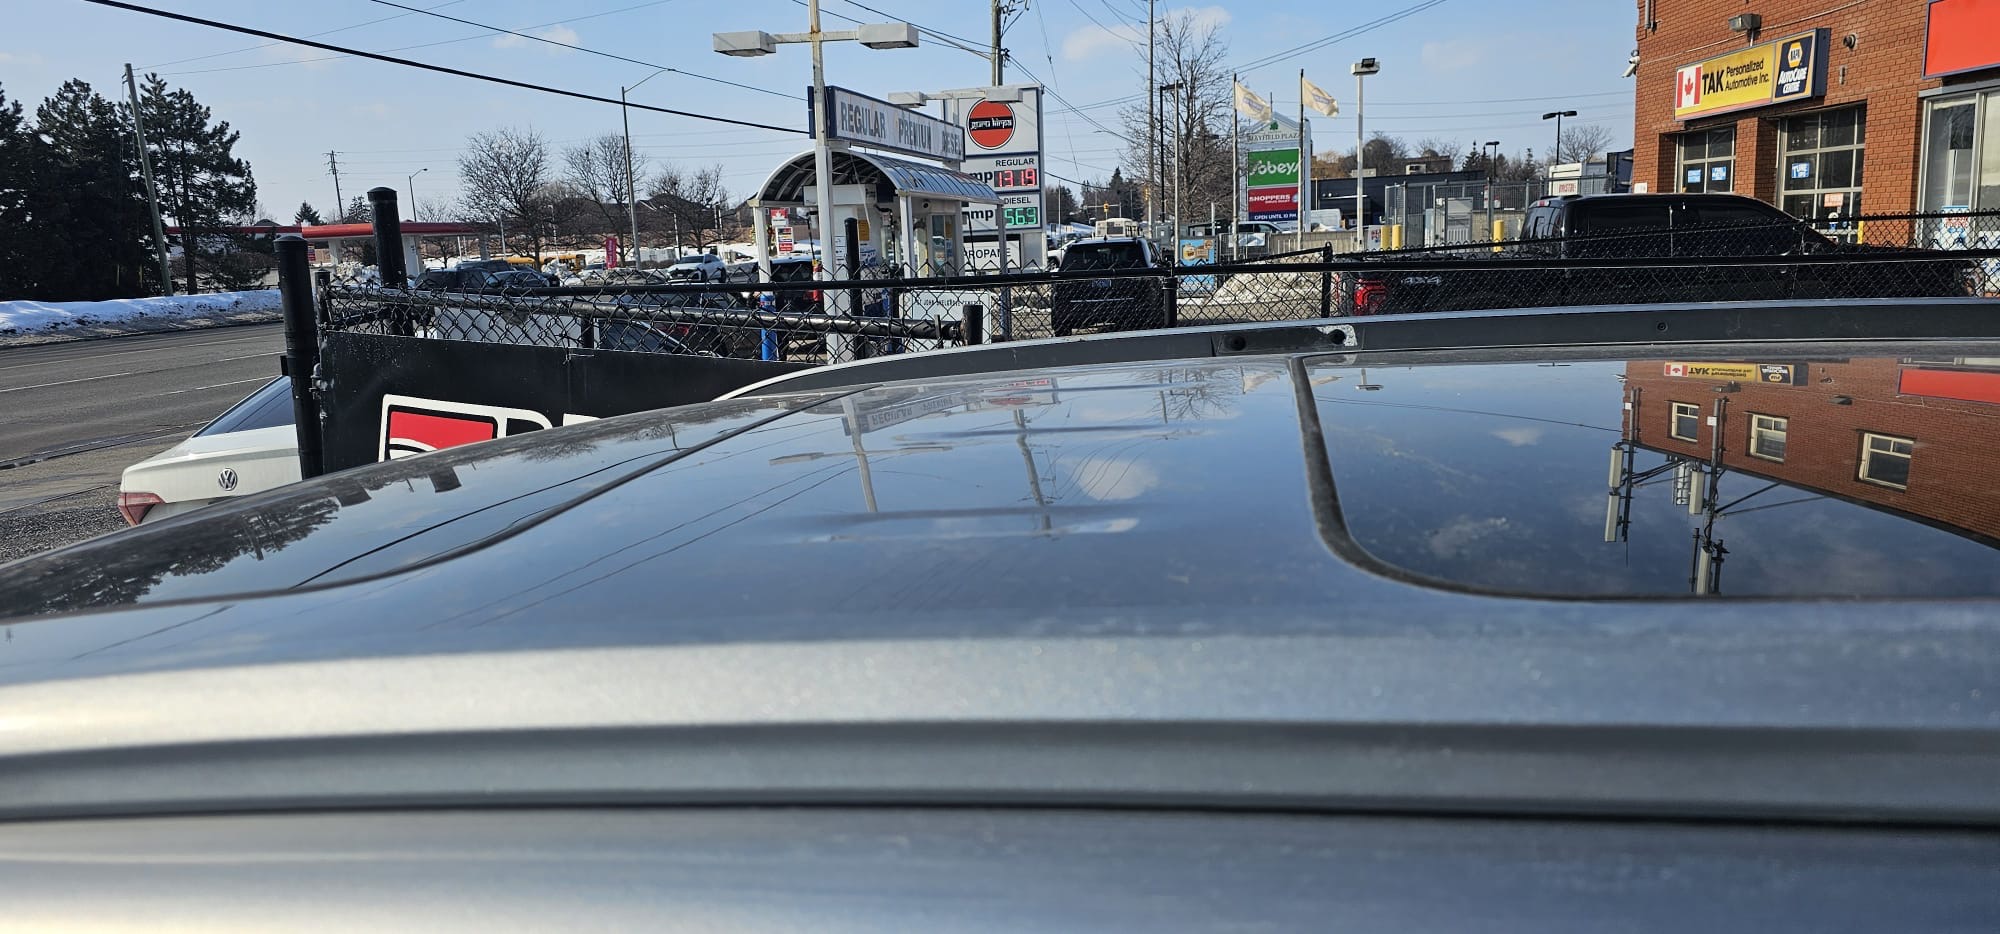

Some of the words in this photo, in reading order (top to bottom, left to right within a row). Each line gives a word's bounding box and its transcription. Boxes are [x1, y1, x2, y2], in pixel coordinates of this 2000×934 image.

[1726, 59, 1764, 77] Personalized
[1702, 70, 1724, 95] TAK
[1725, 75, 1758, 91] Automotive
[1759, 72, 1769, 84] Inc.
[840, 102, 886, 139] REGULAR
[898, 117, 932, 152] PREMIUM
[995, 158, 1035, 167] REGULAR
[1004, 196, 1031, 205] DIESEL
[1249, 194, 1291, 202] SHOPPERS
